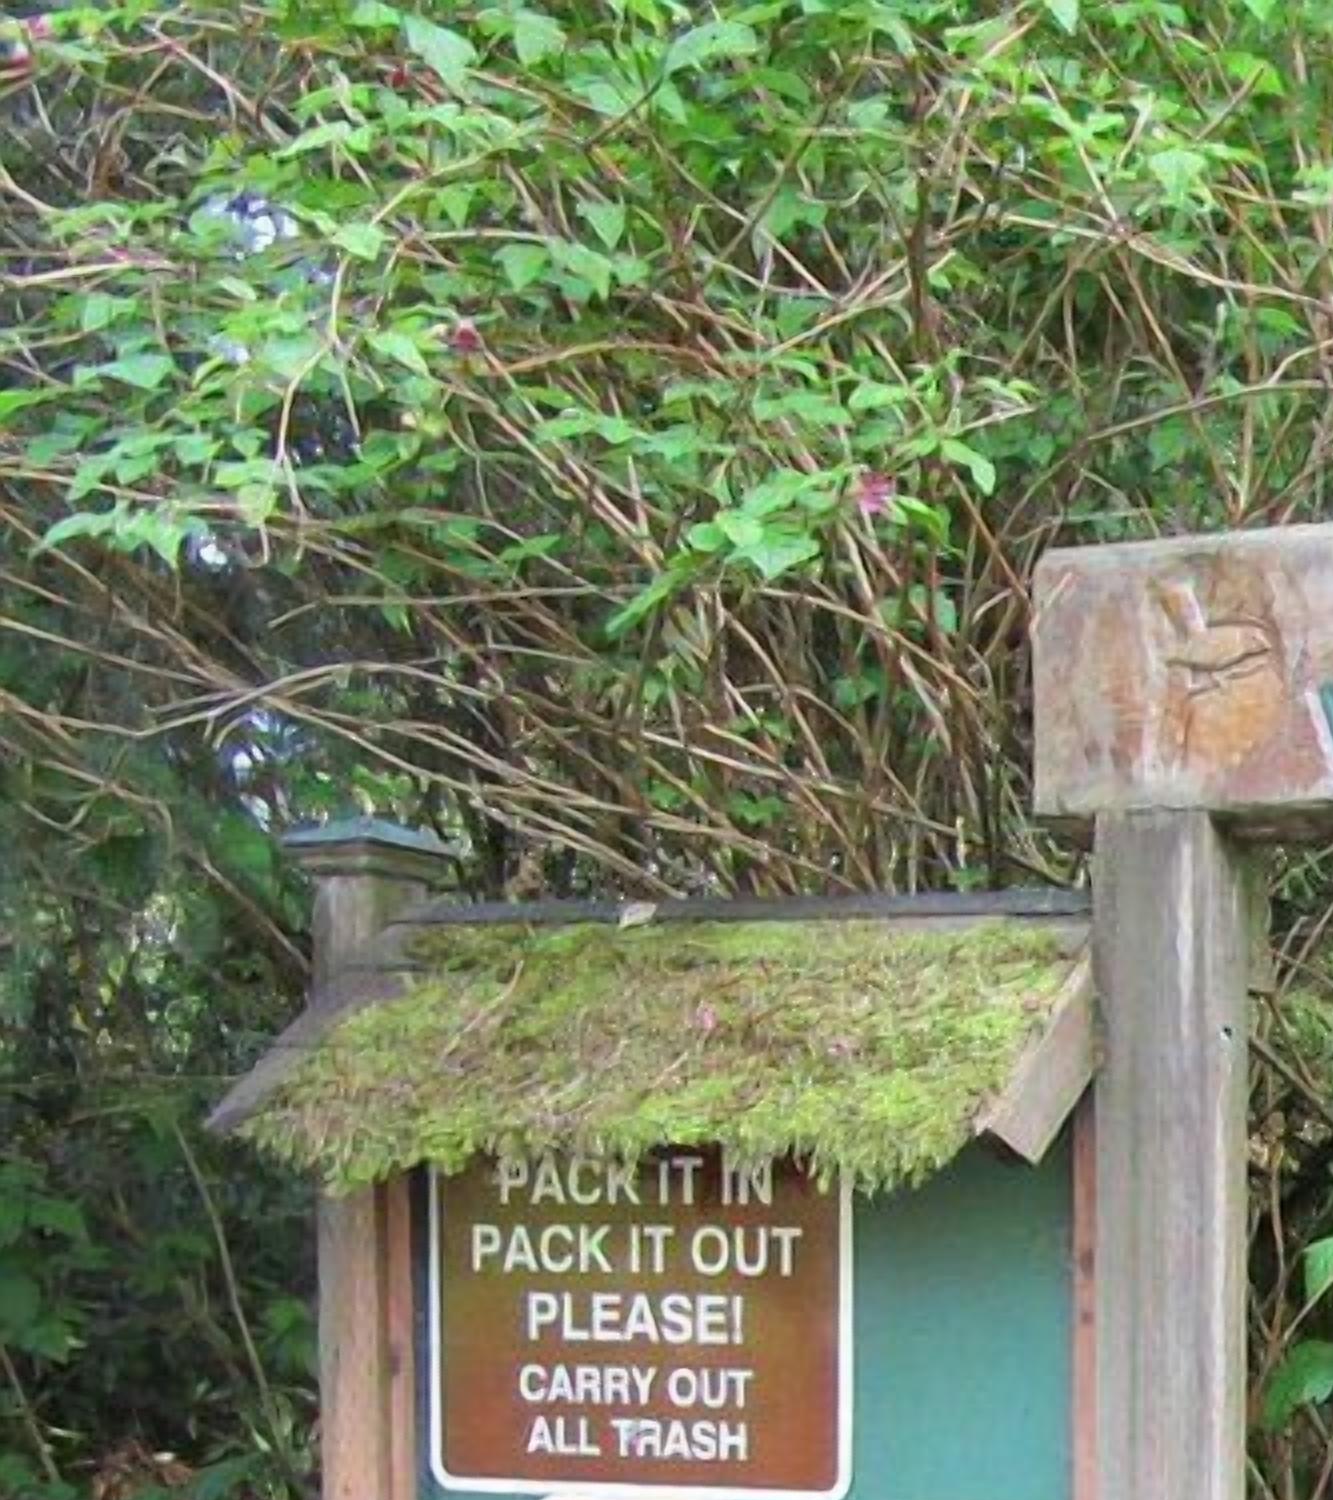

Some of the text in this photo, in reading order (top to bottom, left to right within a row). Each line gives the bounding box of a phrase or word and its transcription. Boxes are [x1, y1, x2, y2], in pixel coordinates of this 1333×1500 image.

[498, 1152, 774, 1206] PACK IT IN
[471, 1224, 803, 1277] PACK IT OUT
[527, 1291, 744, 1345] PLEASE!
[518, 1364, 754, 1409] CARRY OUT
[526, 1416, 748, 1462] ALL TRASH
